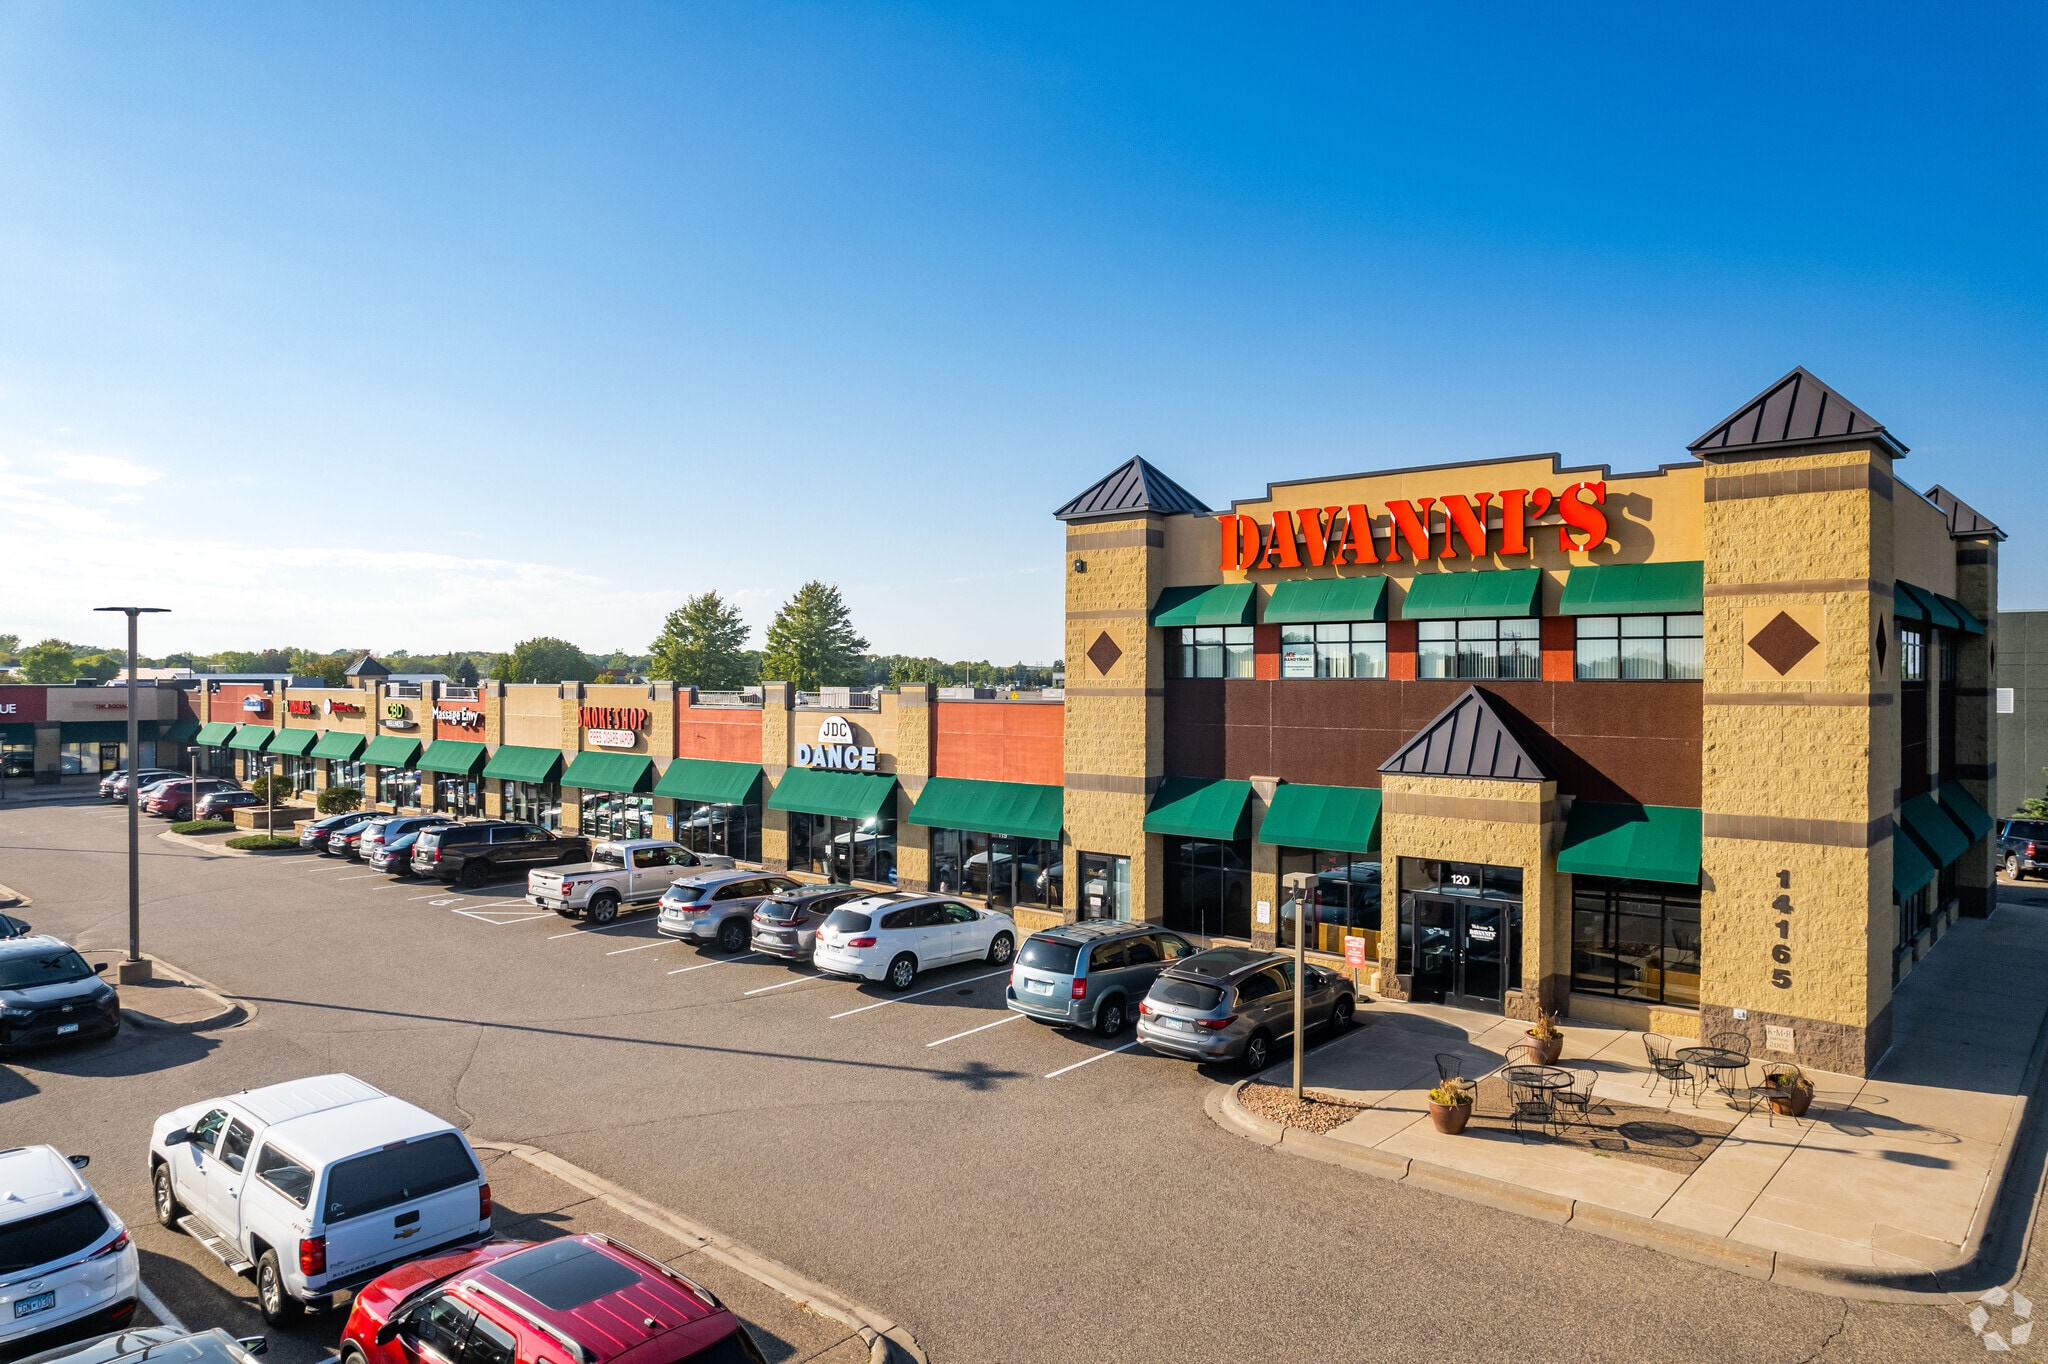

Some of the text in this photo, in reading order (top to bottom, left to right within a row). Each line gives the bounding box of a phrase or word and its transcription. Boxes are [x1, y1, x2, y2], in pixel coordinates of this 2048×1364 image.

[1219, 480, 1608, 571] DAVANNI'S
[289, 700, 311, 715] NAILS
[386, 703, 404, 719] CBD
[432, 706, 479, 727] Massage Envy
[578, 706, 645, 730] SMOKE SHOP
[823, 722, 847, 737] JDC
[796, 743, 876, 771] DANCE
[1451, 874, 1470, 885] 120
[332, 1260, 377, 1278] SILVERADO
